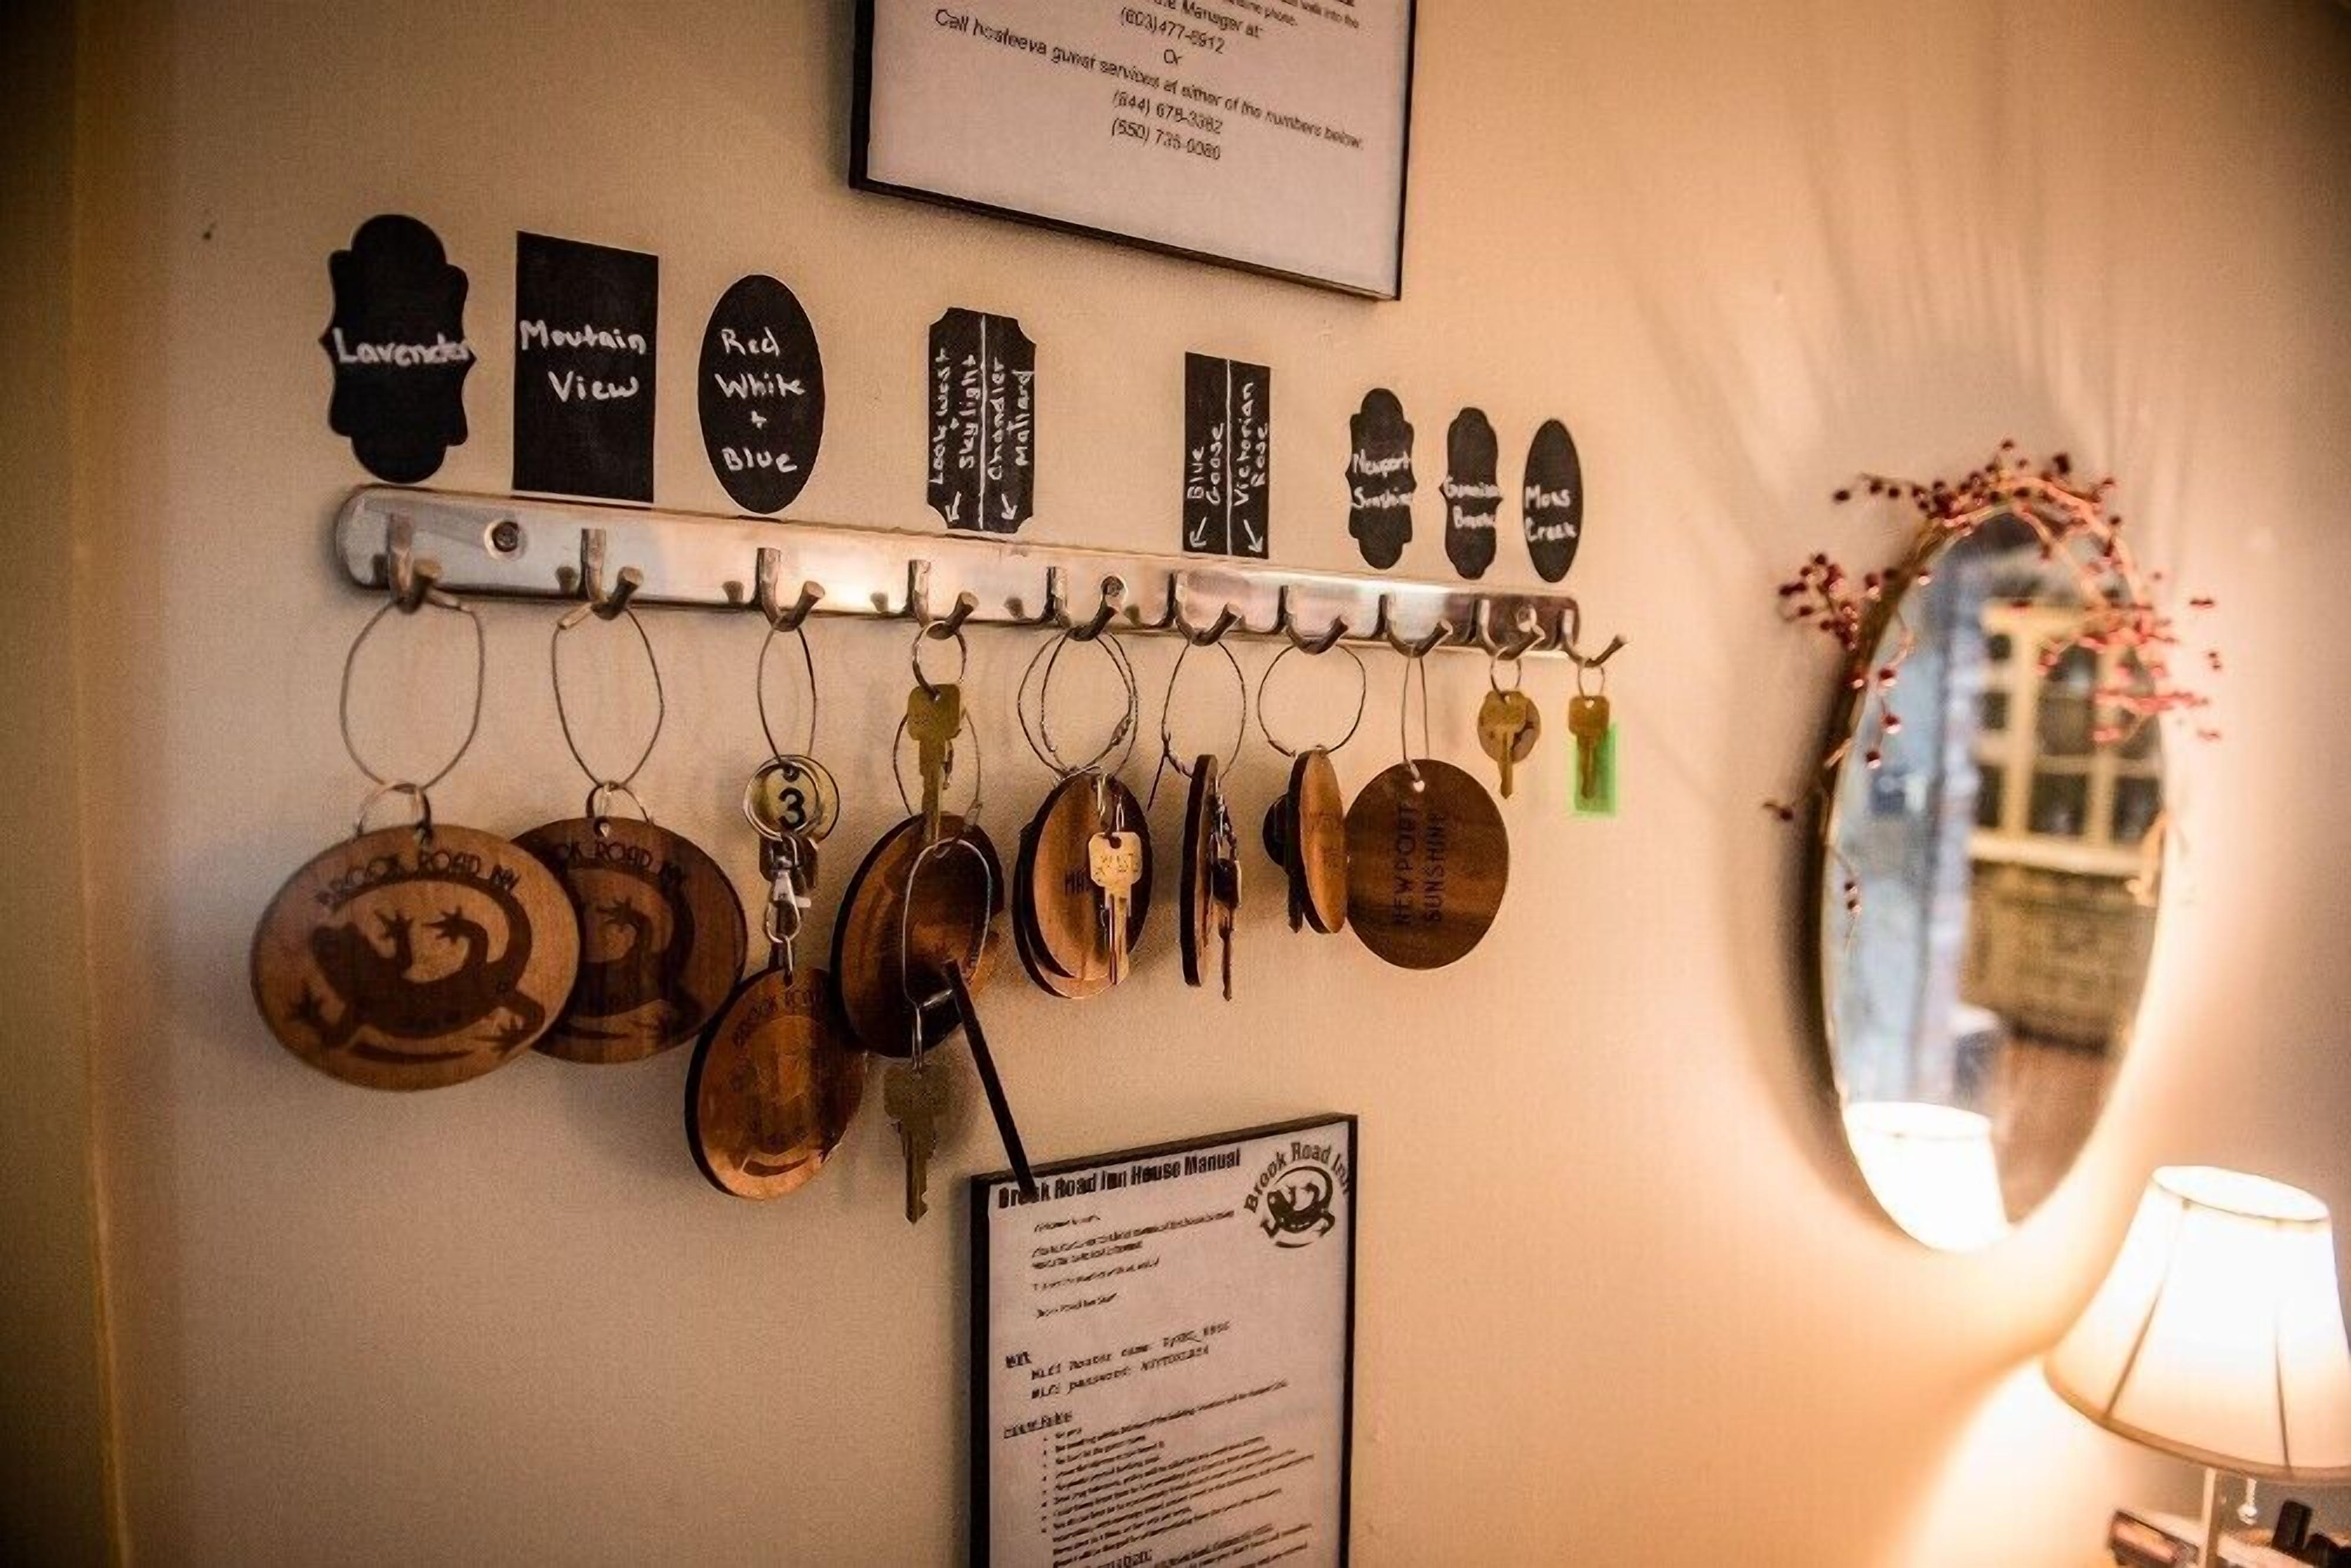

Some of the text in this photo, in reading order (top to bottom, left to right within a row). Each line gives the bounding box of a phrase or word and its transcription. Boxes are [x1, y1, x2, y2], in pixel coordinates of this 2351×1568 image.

[935, 9, 969, 32] Call
[1100, 60, 1160, 88] services
[1265, 110, 1321, 137] numbers
[1164, 49, 1183, 65] Or
[721, 326, 781, 357] Red
[547, 370, 640, 403] View
[714, 371, 806, 400] White
[721, 446, 798, 473] Blue
[929, 424, 949, 485] Look
[1232, 381, 1255, 507] Victorian
[1250, 421, 1269, 488] Rose
[1187, 445, 1205, 500] Blue
[778, 786, 806, 830] 3
[1054, 1172, 1097, 1200] Road
[1130, 1161, 1181, 1185] House
[1184, 1147, 1241, 1177] Manual
[1243, 1151, 1287, 1214] Brook
[1290, 1142, 1332, 1165] Road
